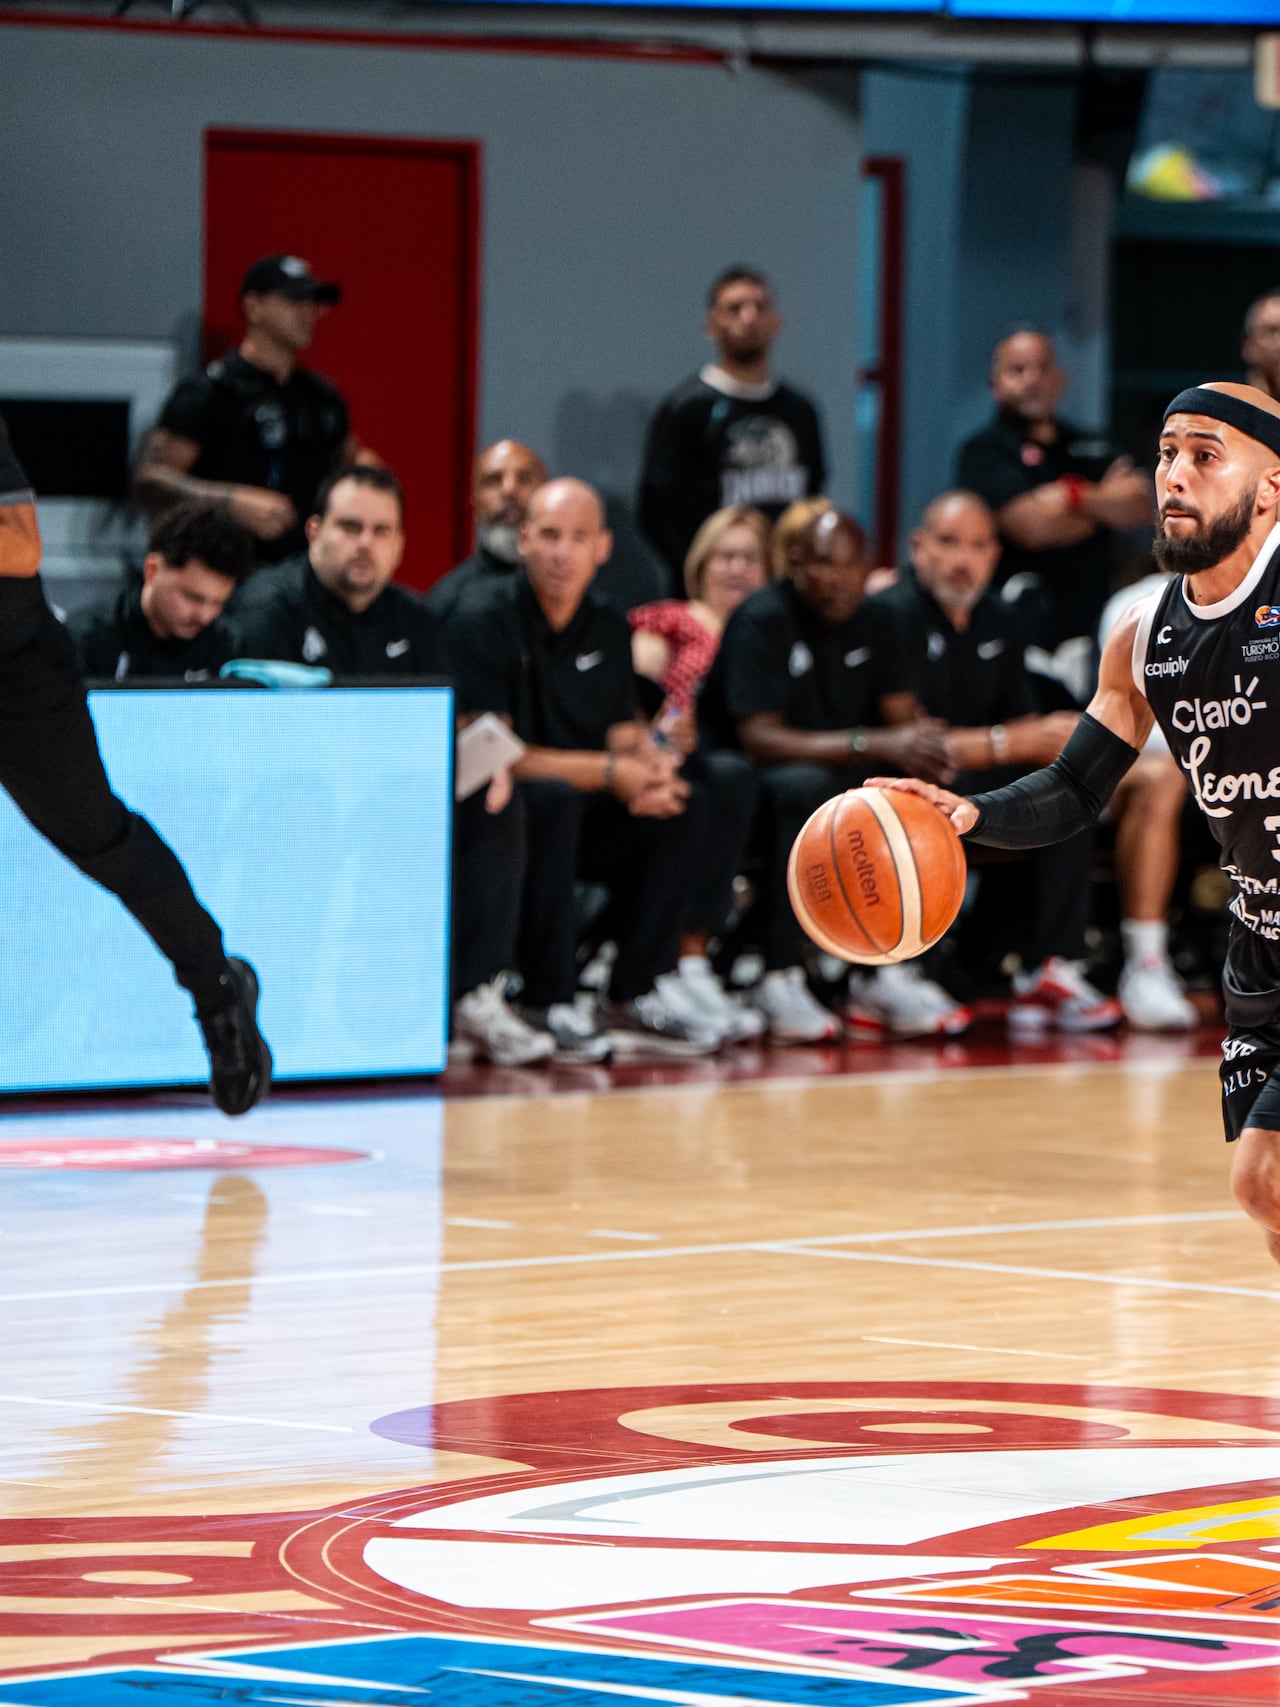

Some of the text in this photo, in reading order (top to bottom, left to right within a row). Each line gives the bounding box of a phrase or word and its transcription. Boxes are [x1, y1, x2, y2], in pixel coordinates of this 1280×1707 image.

[1145, 655, 1190, 678] equiply
[1241, 642, 1279, 657] TURISMO
[1171, 688, 1256, 733] Claro
[847, 829, 881, 907] molten
